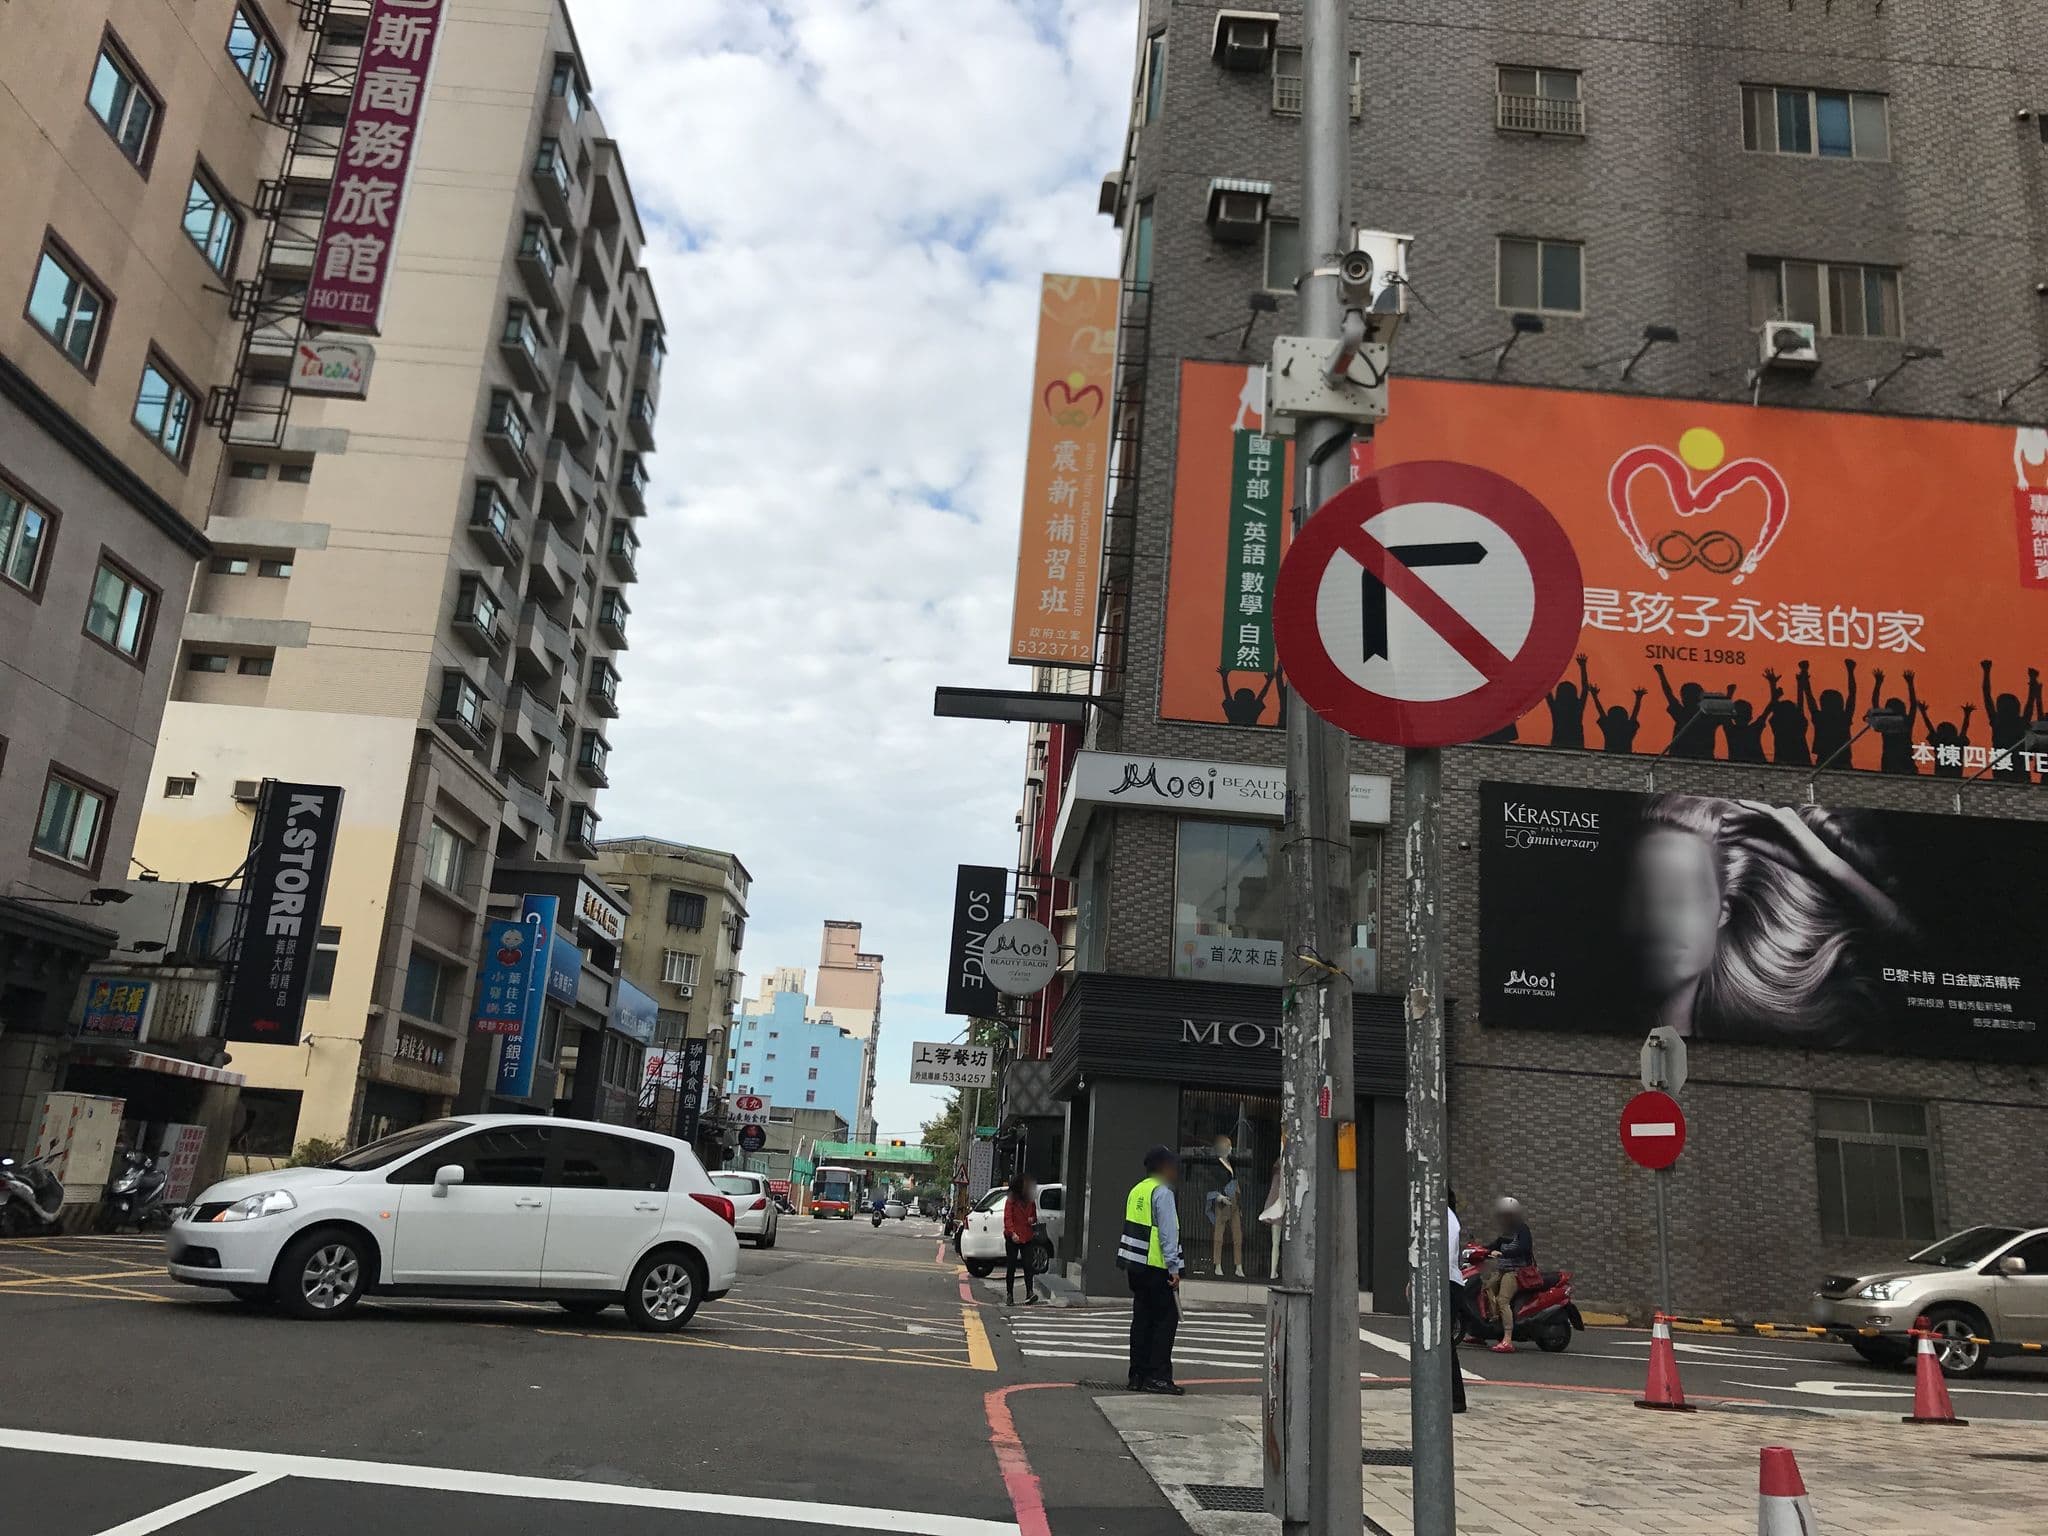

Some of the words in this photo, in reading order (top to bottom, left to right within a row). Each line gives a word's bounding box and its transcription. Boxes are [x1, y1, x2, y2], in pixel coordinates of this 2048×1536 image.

[323, 0, 440, 284] 斯商務旅館
[311, 289, 374, 313] HOTEL
[1038, 440, 1081, 615] 震新補習班
[1077, 500, 1092, 569] educational
[1073, 570, 1088, 617] institute
[1239, 572, 1265, 615] 數學
[1582, 586, 1927, 654] 是孩子永遠的家
[1016, 640, 1090, 658] 5323712
[1236, 623, 1260, 668] 自然
[1645, 644, 1698, 662] SINCE
[1703, 648, 1747, 665] 1988
[1911, 742, 2014, 772] 本棟四樓
[1108, 761, 1218, 800] Mooi
[1222, 776, 1288, 791] BEAUT
[1239, 787, 1285, 800] SALO
[1503, 801, 1600, 829] KÉRASTASE
[1540, 826, 1563, 834] PARIS
[1526, 833, 1600, 852] anniversary
[266, 793, 325, 937] K.STORE
[967, 889, 991, 922] SO
[989, 934, 1049, 958] Mooi
[1210, 944, 1285, 968] 首次來店
[269, 939, 287, 990] 義大利
[961, 929, 988, 989] NICE
[990, 958, 1020, 967] BEAUTY
[1023, 960, 1049, 969] SALON
[1503, 968, 1556, 990] Mooi
[1882, 967, 1936, 985] 巴黎卡詩
[1503, 987, 1531, 996] BEAUTY
[1532, 988, 1556, 998] SALON
[497, 1021, 520, 1033] 7:30
[915, 1047, 988, 1067] 上等餐坊
[942, 1072, 986, 1084] 5334257
